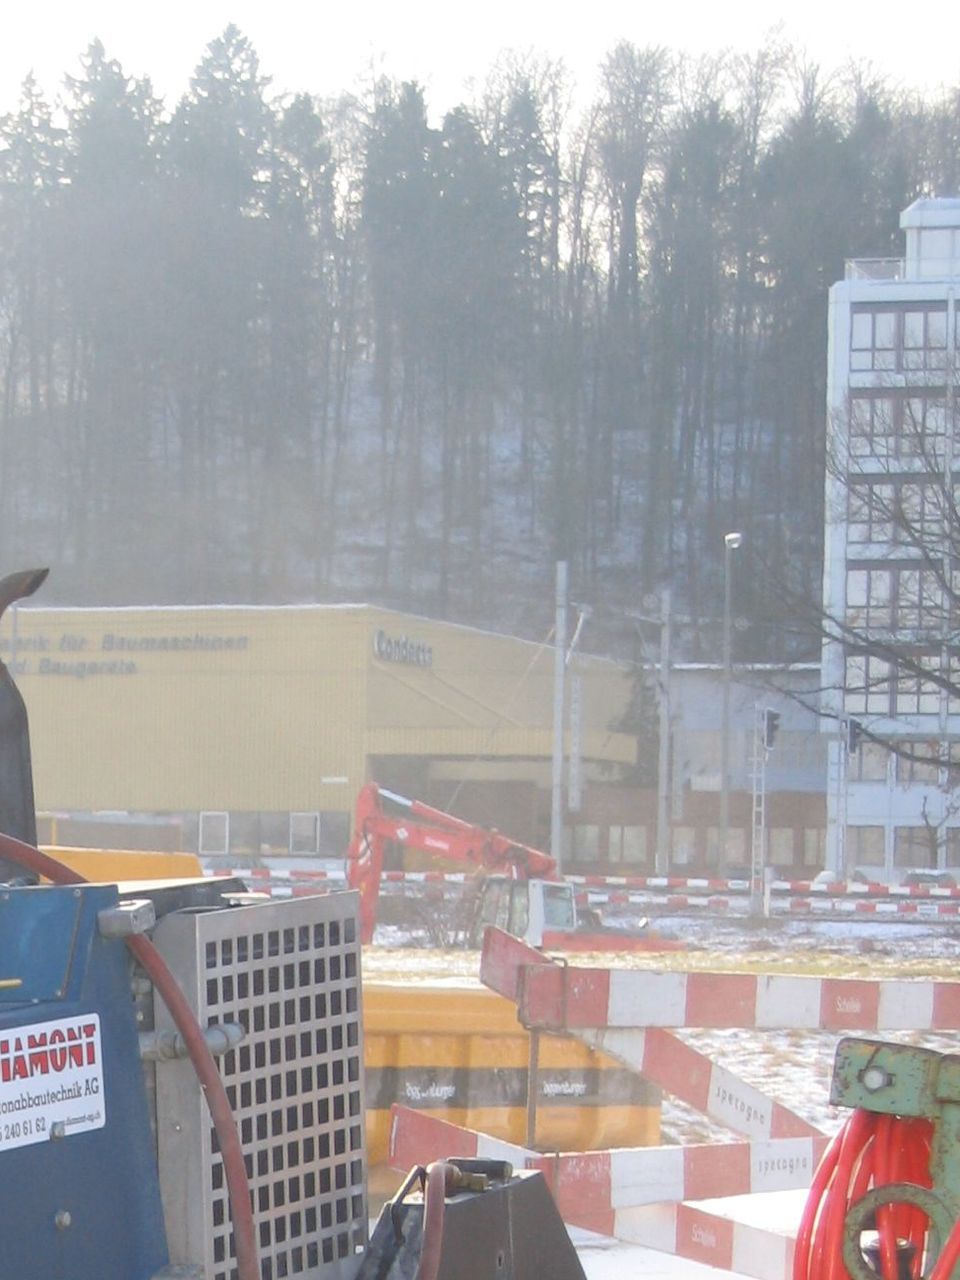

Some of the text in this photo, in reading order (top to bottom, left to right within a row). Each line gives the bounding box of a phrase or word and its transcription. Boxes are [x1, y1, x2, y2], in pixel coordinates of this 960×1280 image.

[83, 1077, 100, 1096] AG
[4, 1122, 21, 1141] 240
[22, 1119, 34, 1137] 61
